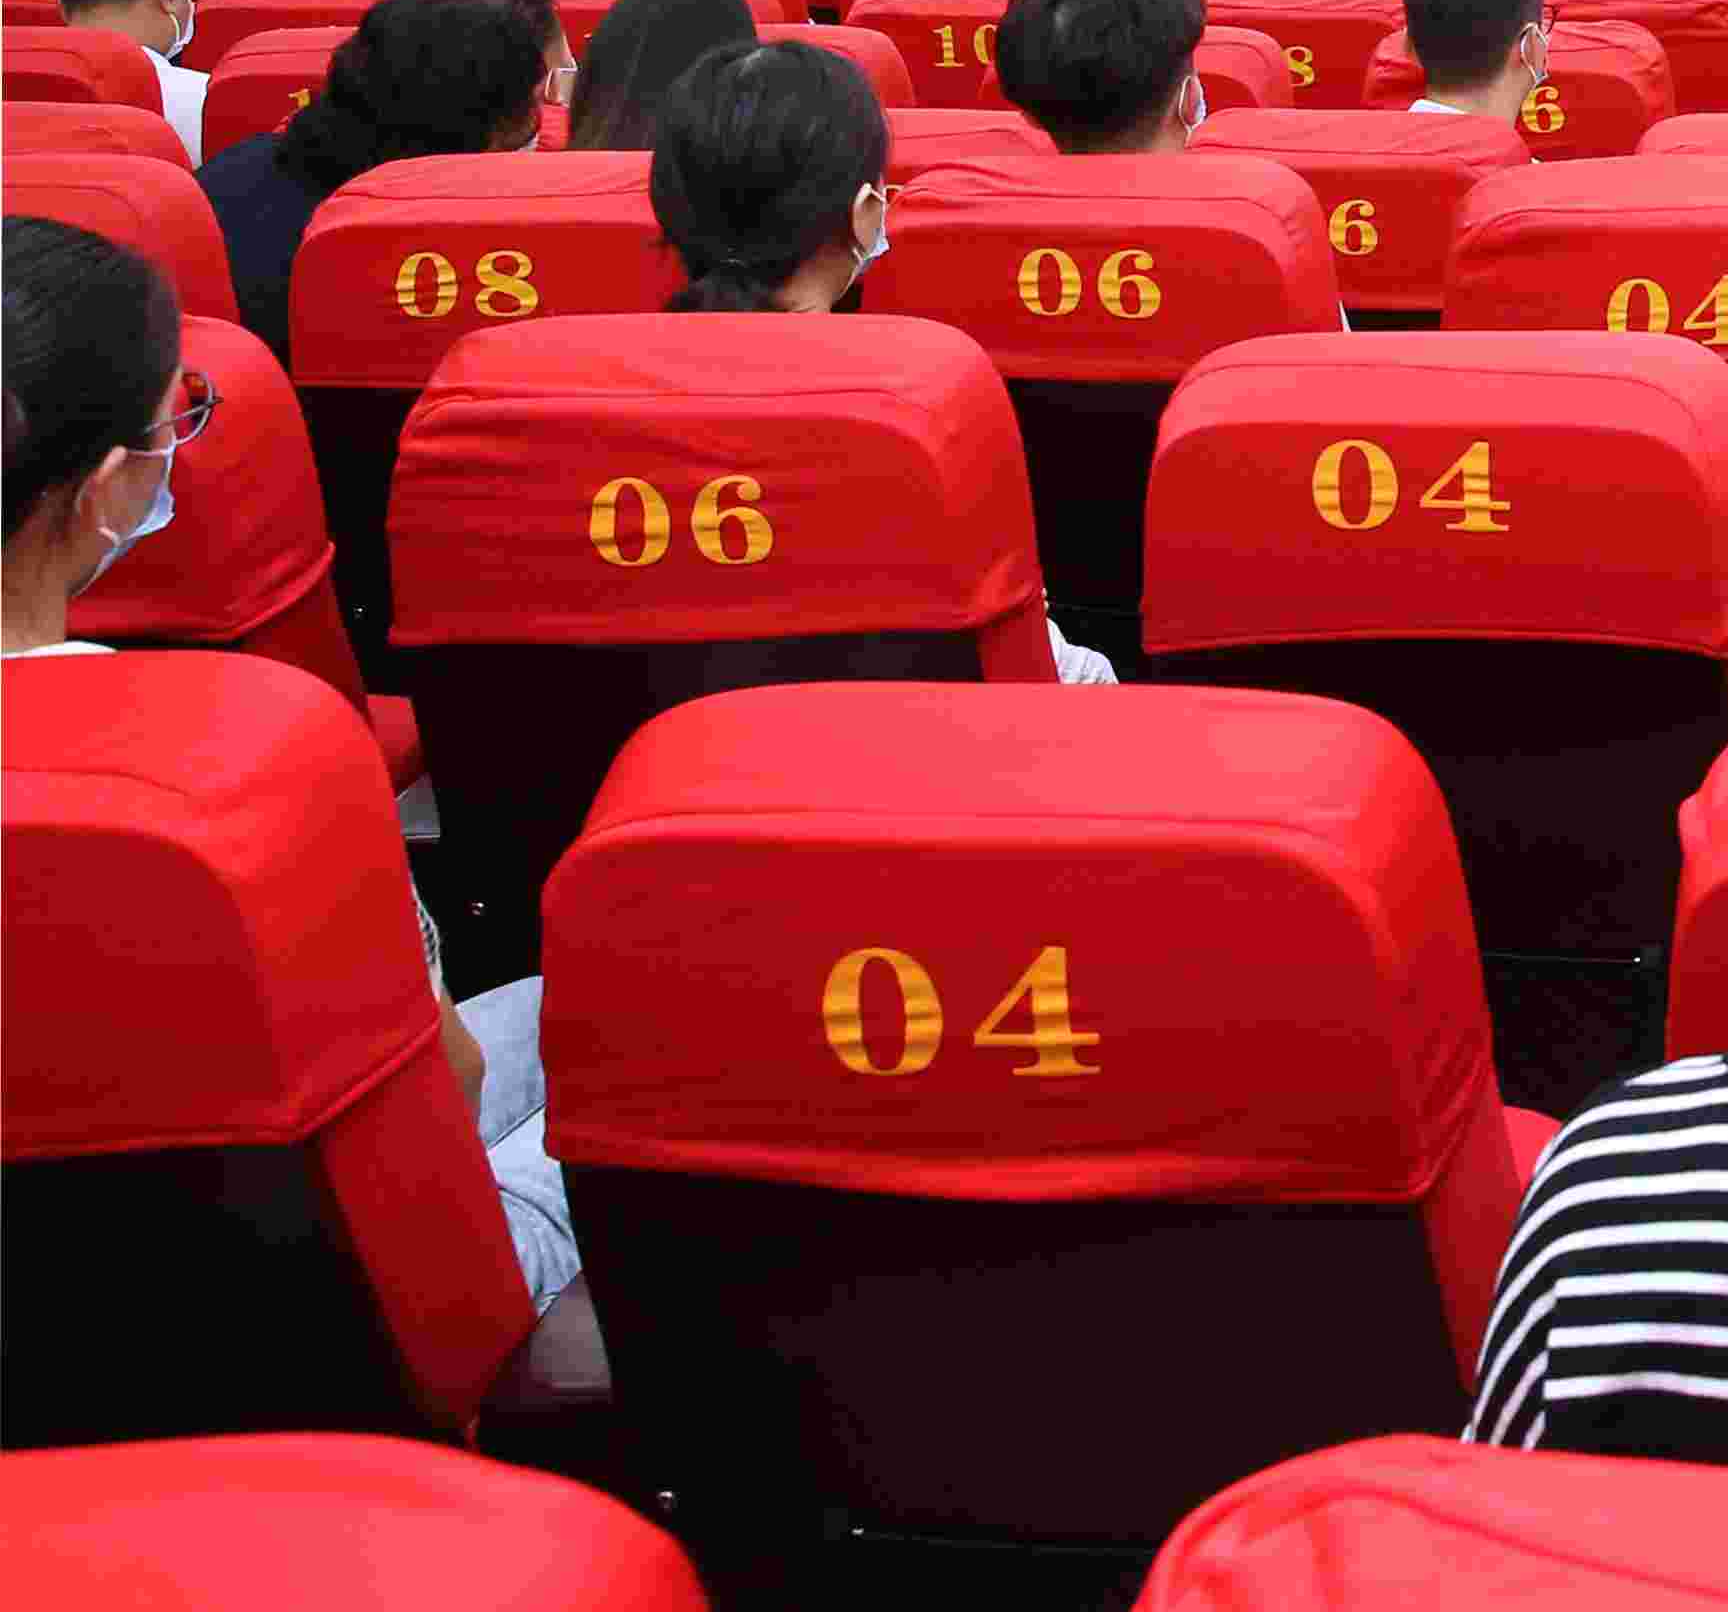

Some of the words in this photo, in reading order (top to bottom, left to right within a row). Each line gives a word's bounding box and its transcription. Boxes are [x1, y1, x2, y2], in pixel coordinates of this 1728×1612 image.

[1281, 44, 1317, 87] 8
[1520, 84, 1568, 134] 6
[1328, 198, 1378, 256] 6
[395, 250, 540, 319] 08
[1017, 247, 1162, 319] 06
[588, 474, 774, 567] 06
[1310, 438, 1512, 533] 04
[821, 944, 1102, 1077] 04
